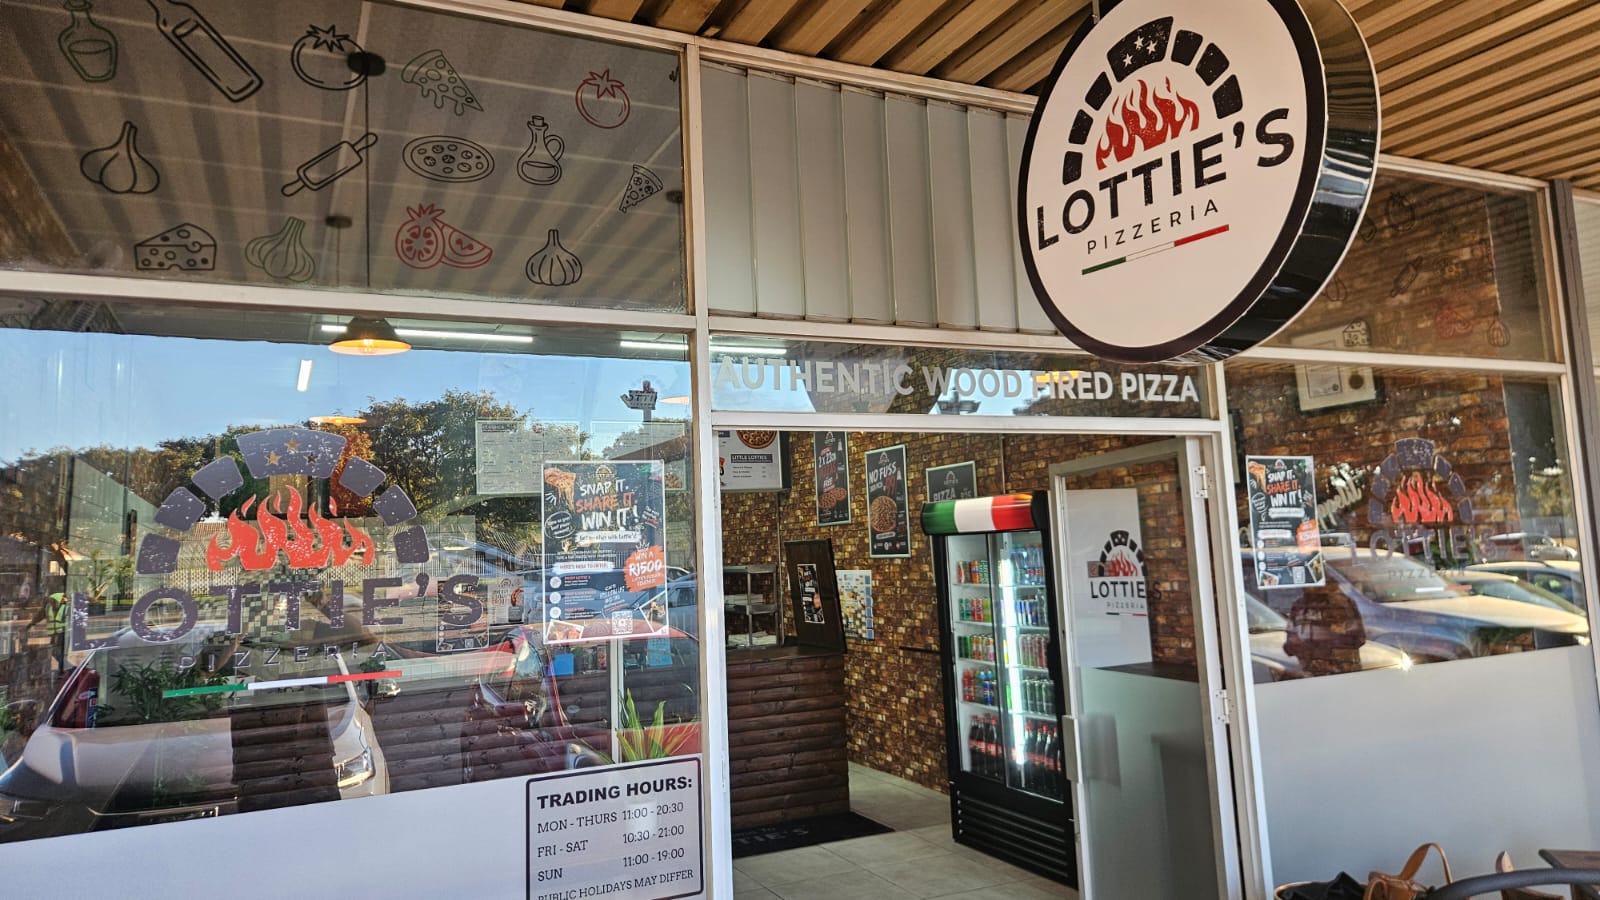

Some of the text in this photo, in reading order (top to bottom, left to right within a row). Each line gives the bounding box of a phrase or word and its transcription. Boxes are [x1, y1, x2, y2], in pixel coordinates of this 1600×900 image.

[1037, 108, 1294, 250] LOTTIE'S
[1087, 200, 1218, 254] PIZZERIA
[715, 356, 1199, 402] AUTHENTIC WOOD FIRED PIZZA
[580, 479, 629, 496] SNAP IT.
[880, 462, 897, 481] FUSS
[576, 492, 638, 513] SHARE IT.
[581, 511, 611, 531] WIN
[617, 505, 639, 528] IT!
[71, 574, 484, 653] LOTTIE'S
[178, 640, 392, 673] PIZZERIA
[537, 776, 692, 809] TRADING HOURS:
[537, 819, 568, 834] MON
[577, 812, 617, 828] THURS
[622, 807, 648, 821] 11:00
[656, 802, 684, 816] 20:30
[537, 845, 557, 858] FRI
[566, 840, 589, 853] SAT
[623, 830, 650, 844] 10:30
[658, 825, 685, 838] 21:00
[538, 868, 563, 882] SUN
[623, 854, 649, 868] 11:00
[658, 848, 685, 861] 19:00
[579, 879, 632, 899] HOLIDAYS
[634, 875, 657, 888] MAY
[660, 869, 694, 884] DIFFER
